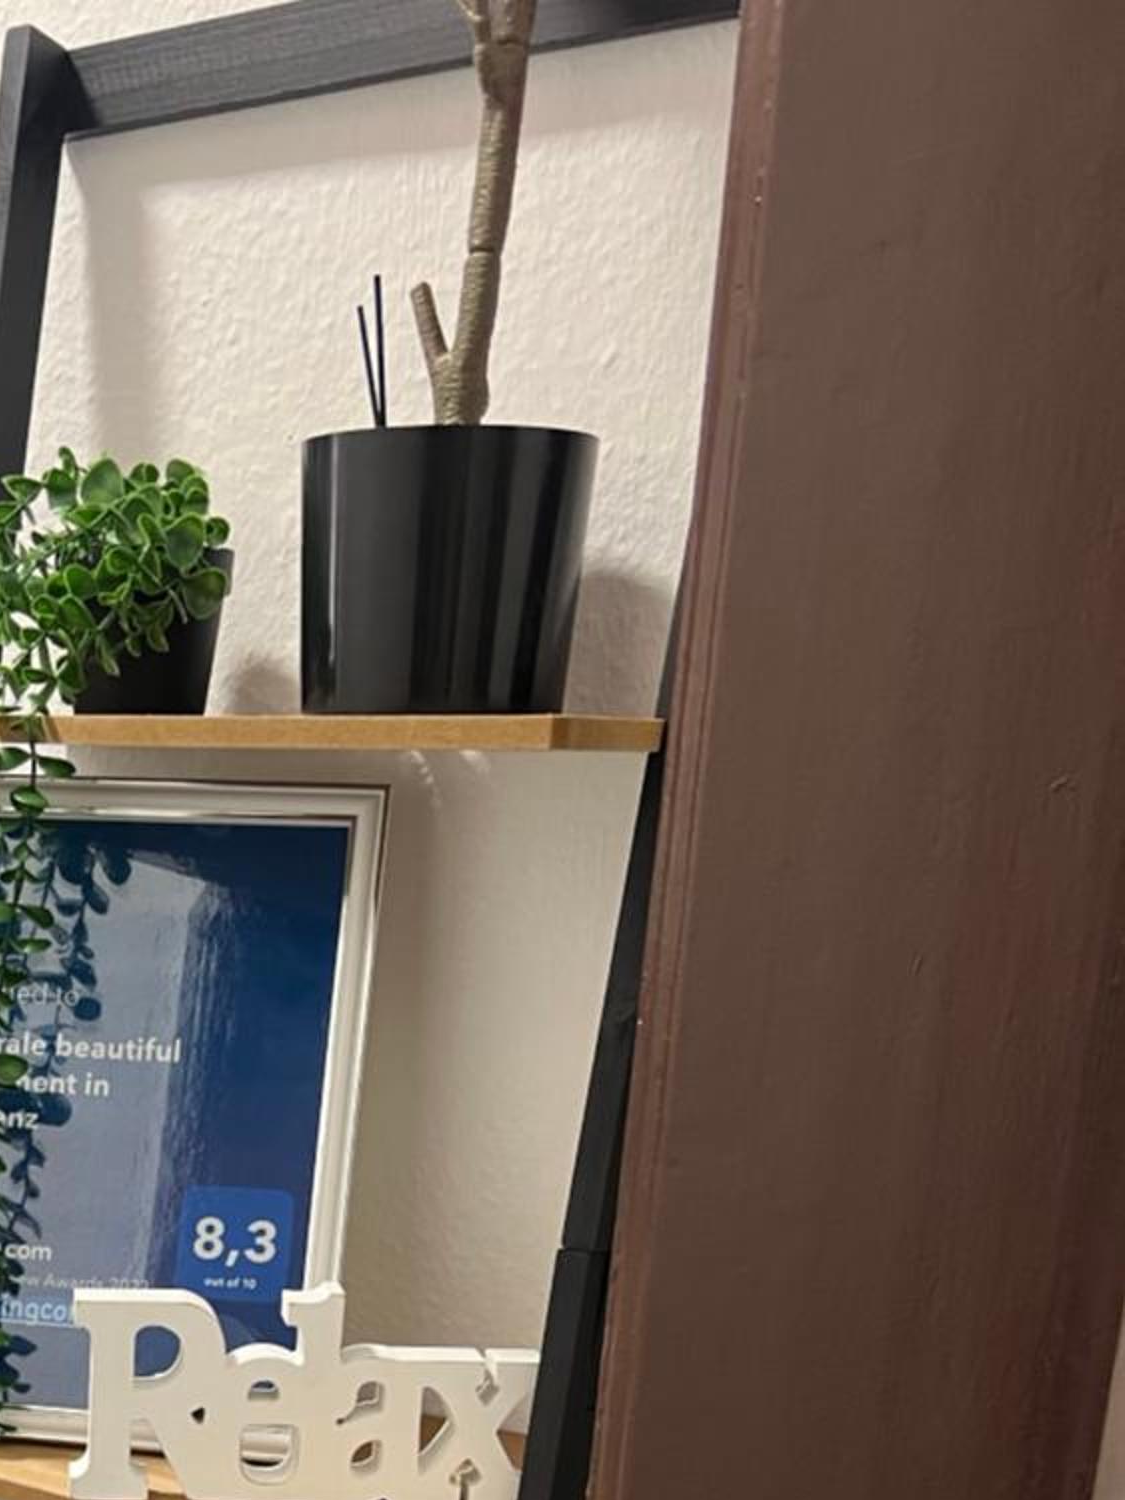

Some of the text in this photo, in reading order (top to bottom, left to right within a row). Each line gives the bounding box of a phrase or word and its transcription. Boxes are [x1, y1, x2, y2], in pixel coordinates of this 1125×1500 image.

[55, 1032, 182, 1064] beautiful
[84, 1072, 111, 1097] in
[193, 1216, 277, 1268] 8,3
